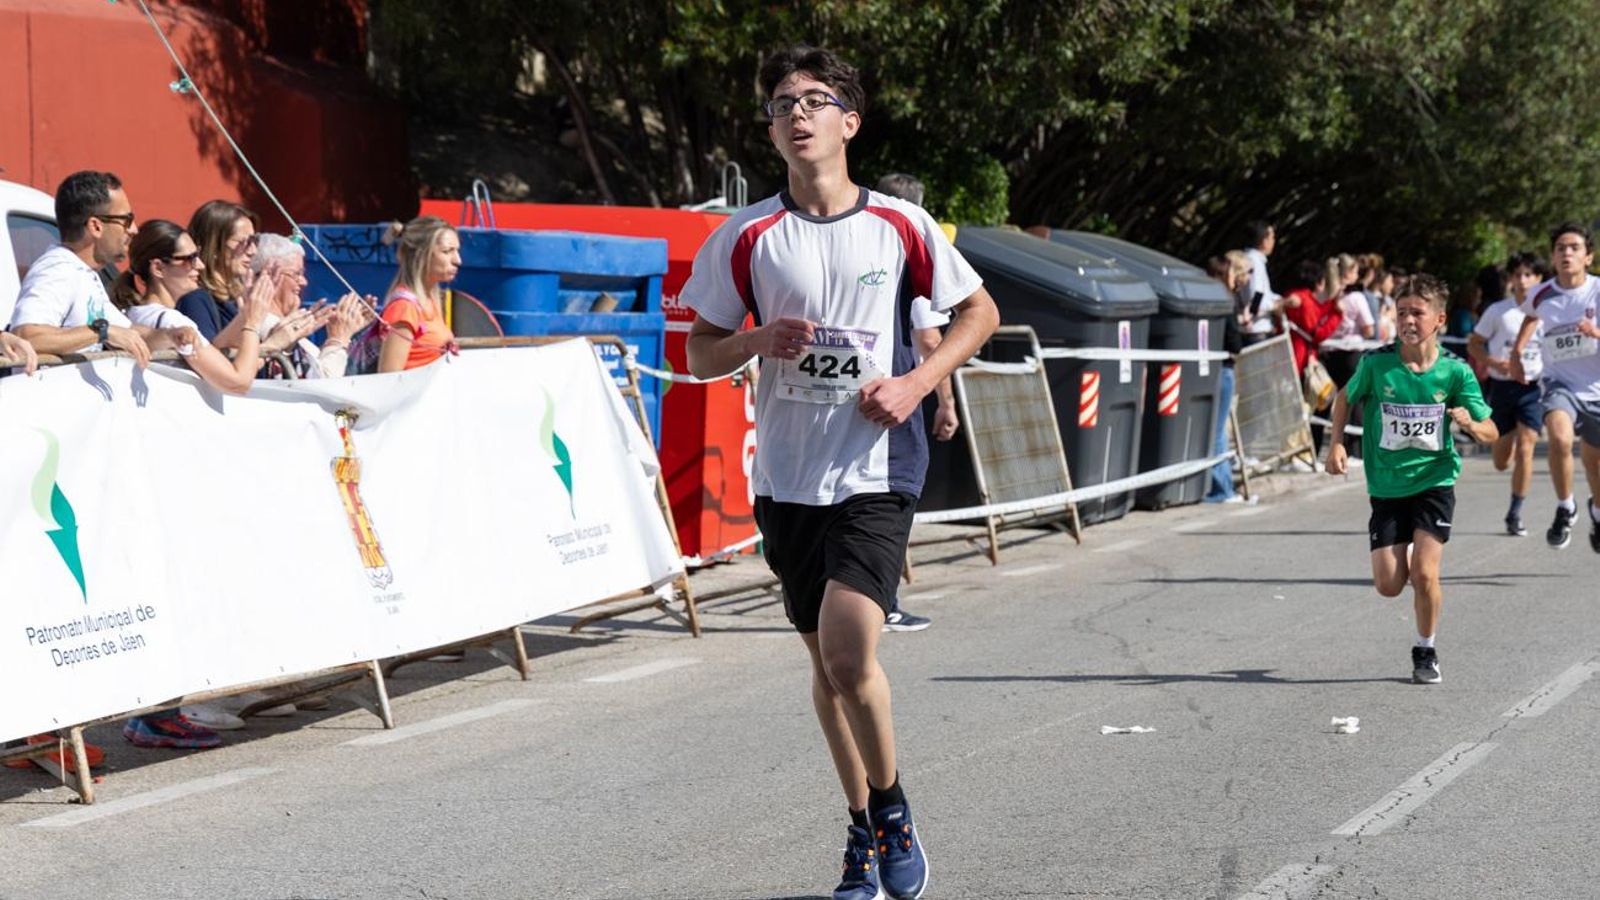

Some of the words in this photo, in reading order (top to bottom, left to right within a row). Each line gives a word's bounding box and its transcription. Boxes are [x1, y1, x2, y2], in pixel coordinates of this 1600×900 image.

[1555, 335, 1582, 349] 867
[798, 353, 861, 379] 424
[1389, 420, 1435, 437] 1328
[25, 619, 83, 645] Patronato
[83, 607, 134, 632] Municipal
[135, 604, 156, 622] de
[51, 644, 100, 668] Deportes
[101, 636, 118, 656] de
[119, 633, 146, 651] Jaén
